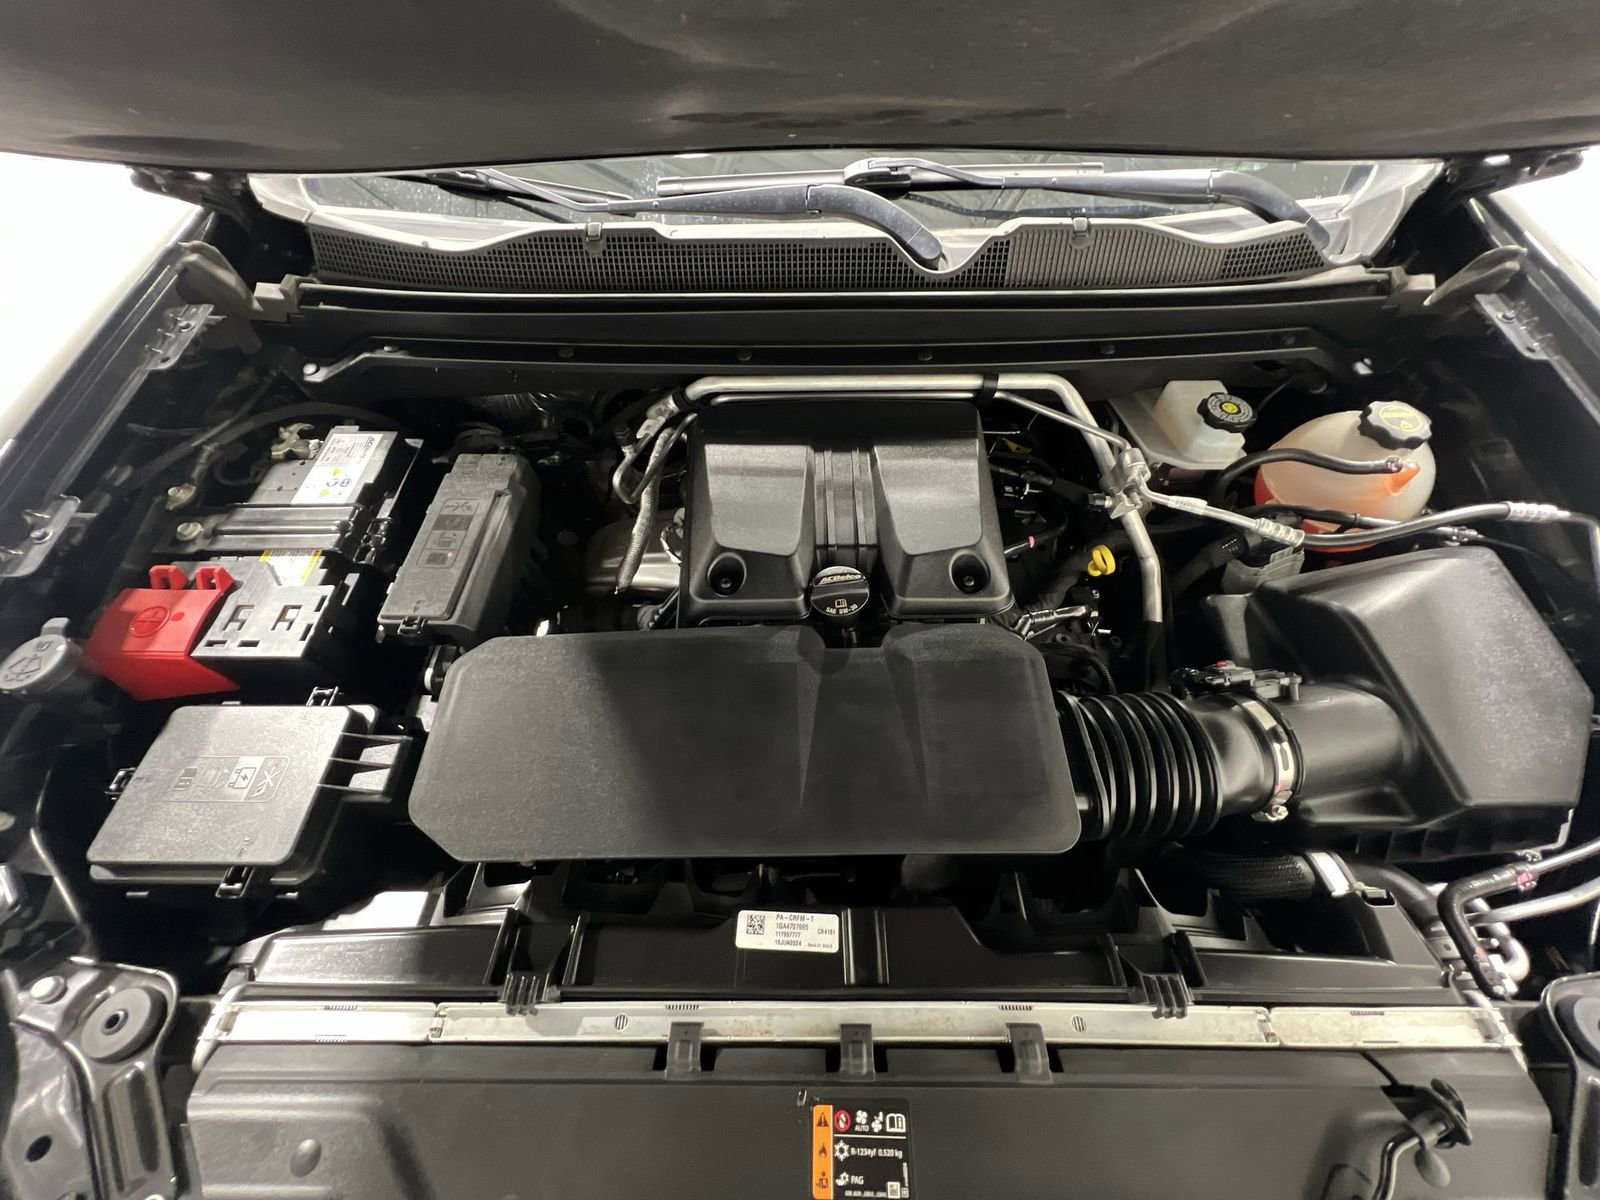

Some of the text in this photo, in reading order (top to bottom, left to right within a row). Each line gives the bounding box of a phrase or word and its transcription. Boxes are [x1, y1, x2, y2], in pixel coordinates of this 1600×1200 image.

[819, 574, 862, 585] ACDelco
[826, 606, 837, 614] SAE
[776, 913, 815, 922] PA-CRFM-T
[854, 1124, 870, 1132] AUTO
[850, 1147, 903, 1159] R-1234yf 0.520 kg
[850, 1175, 864, 1185] PAG
